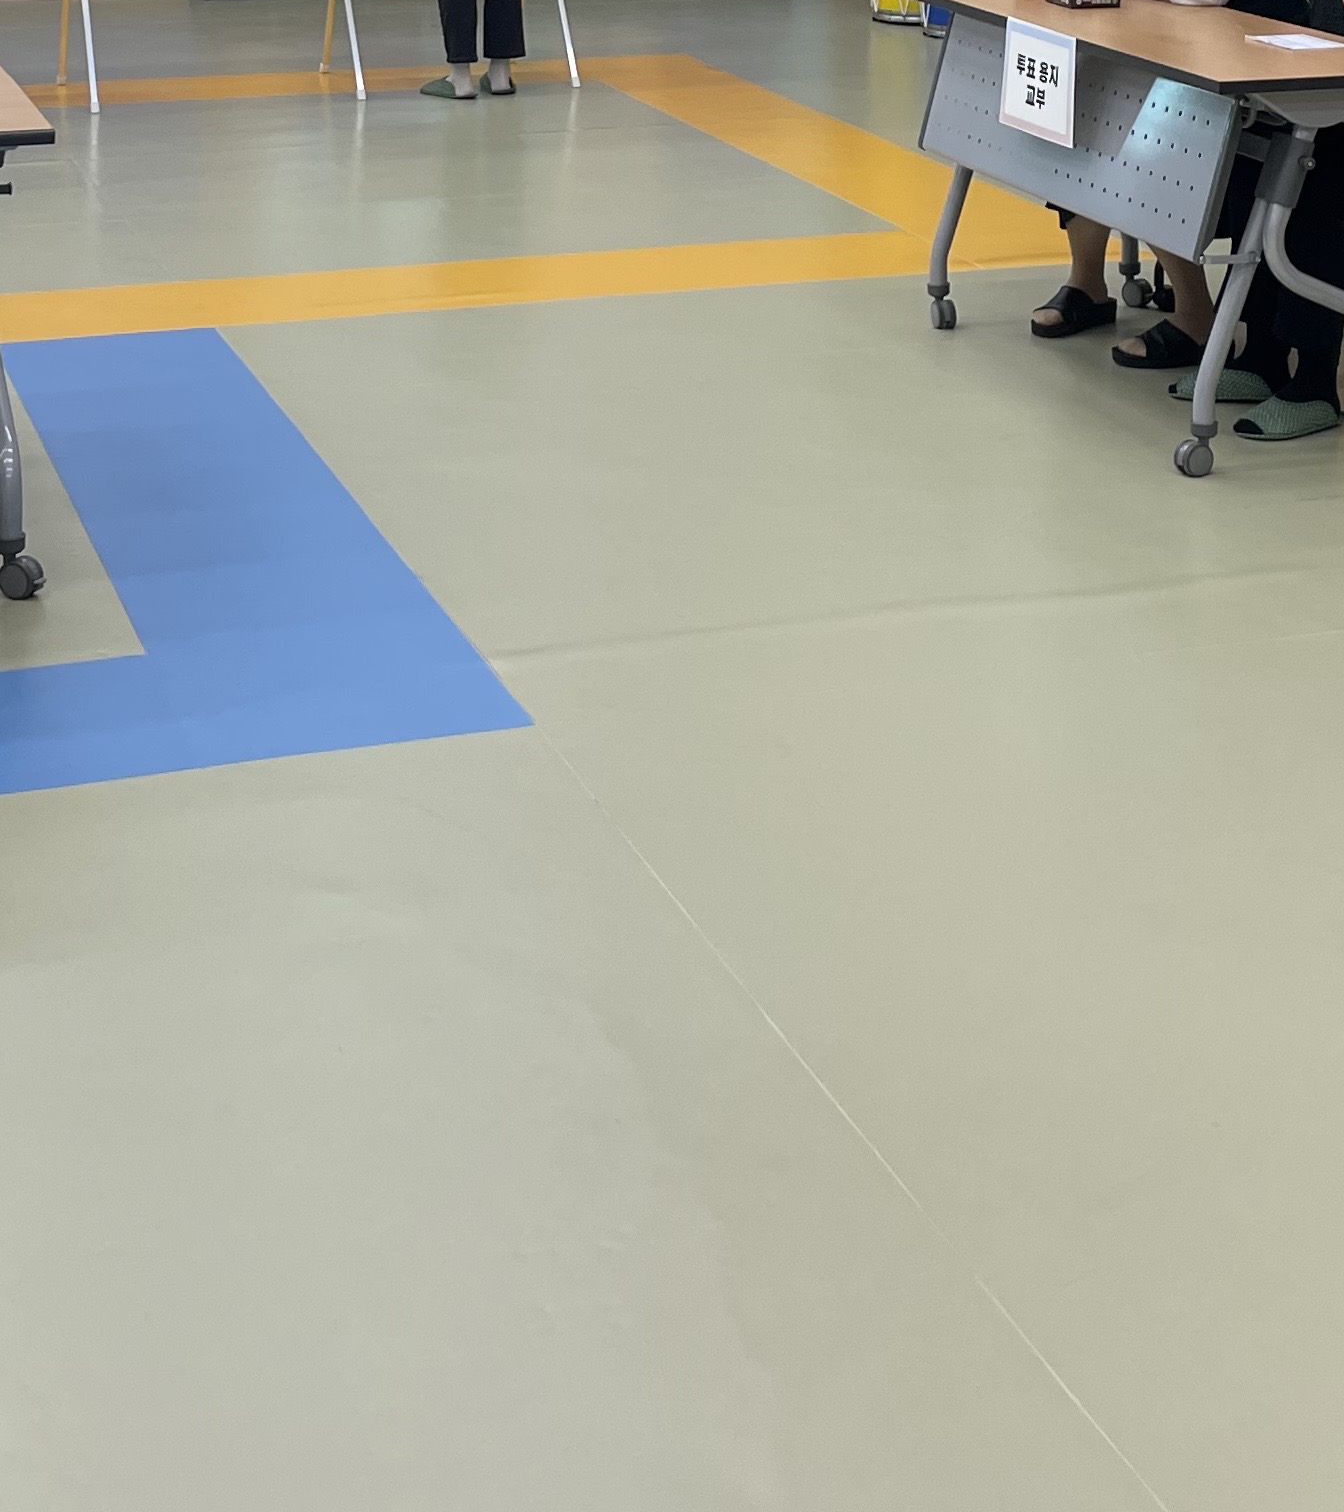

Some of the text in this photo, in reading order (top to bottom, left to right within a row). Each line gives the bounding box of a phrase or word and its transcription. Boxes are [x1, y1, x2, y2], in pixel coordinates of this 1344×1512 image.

[1016, 53, 1059, 87] 투표 용지
[1025, 84, 1045, 108] 교부
